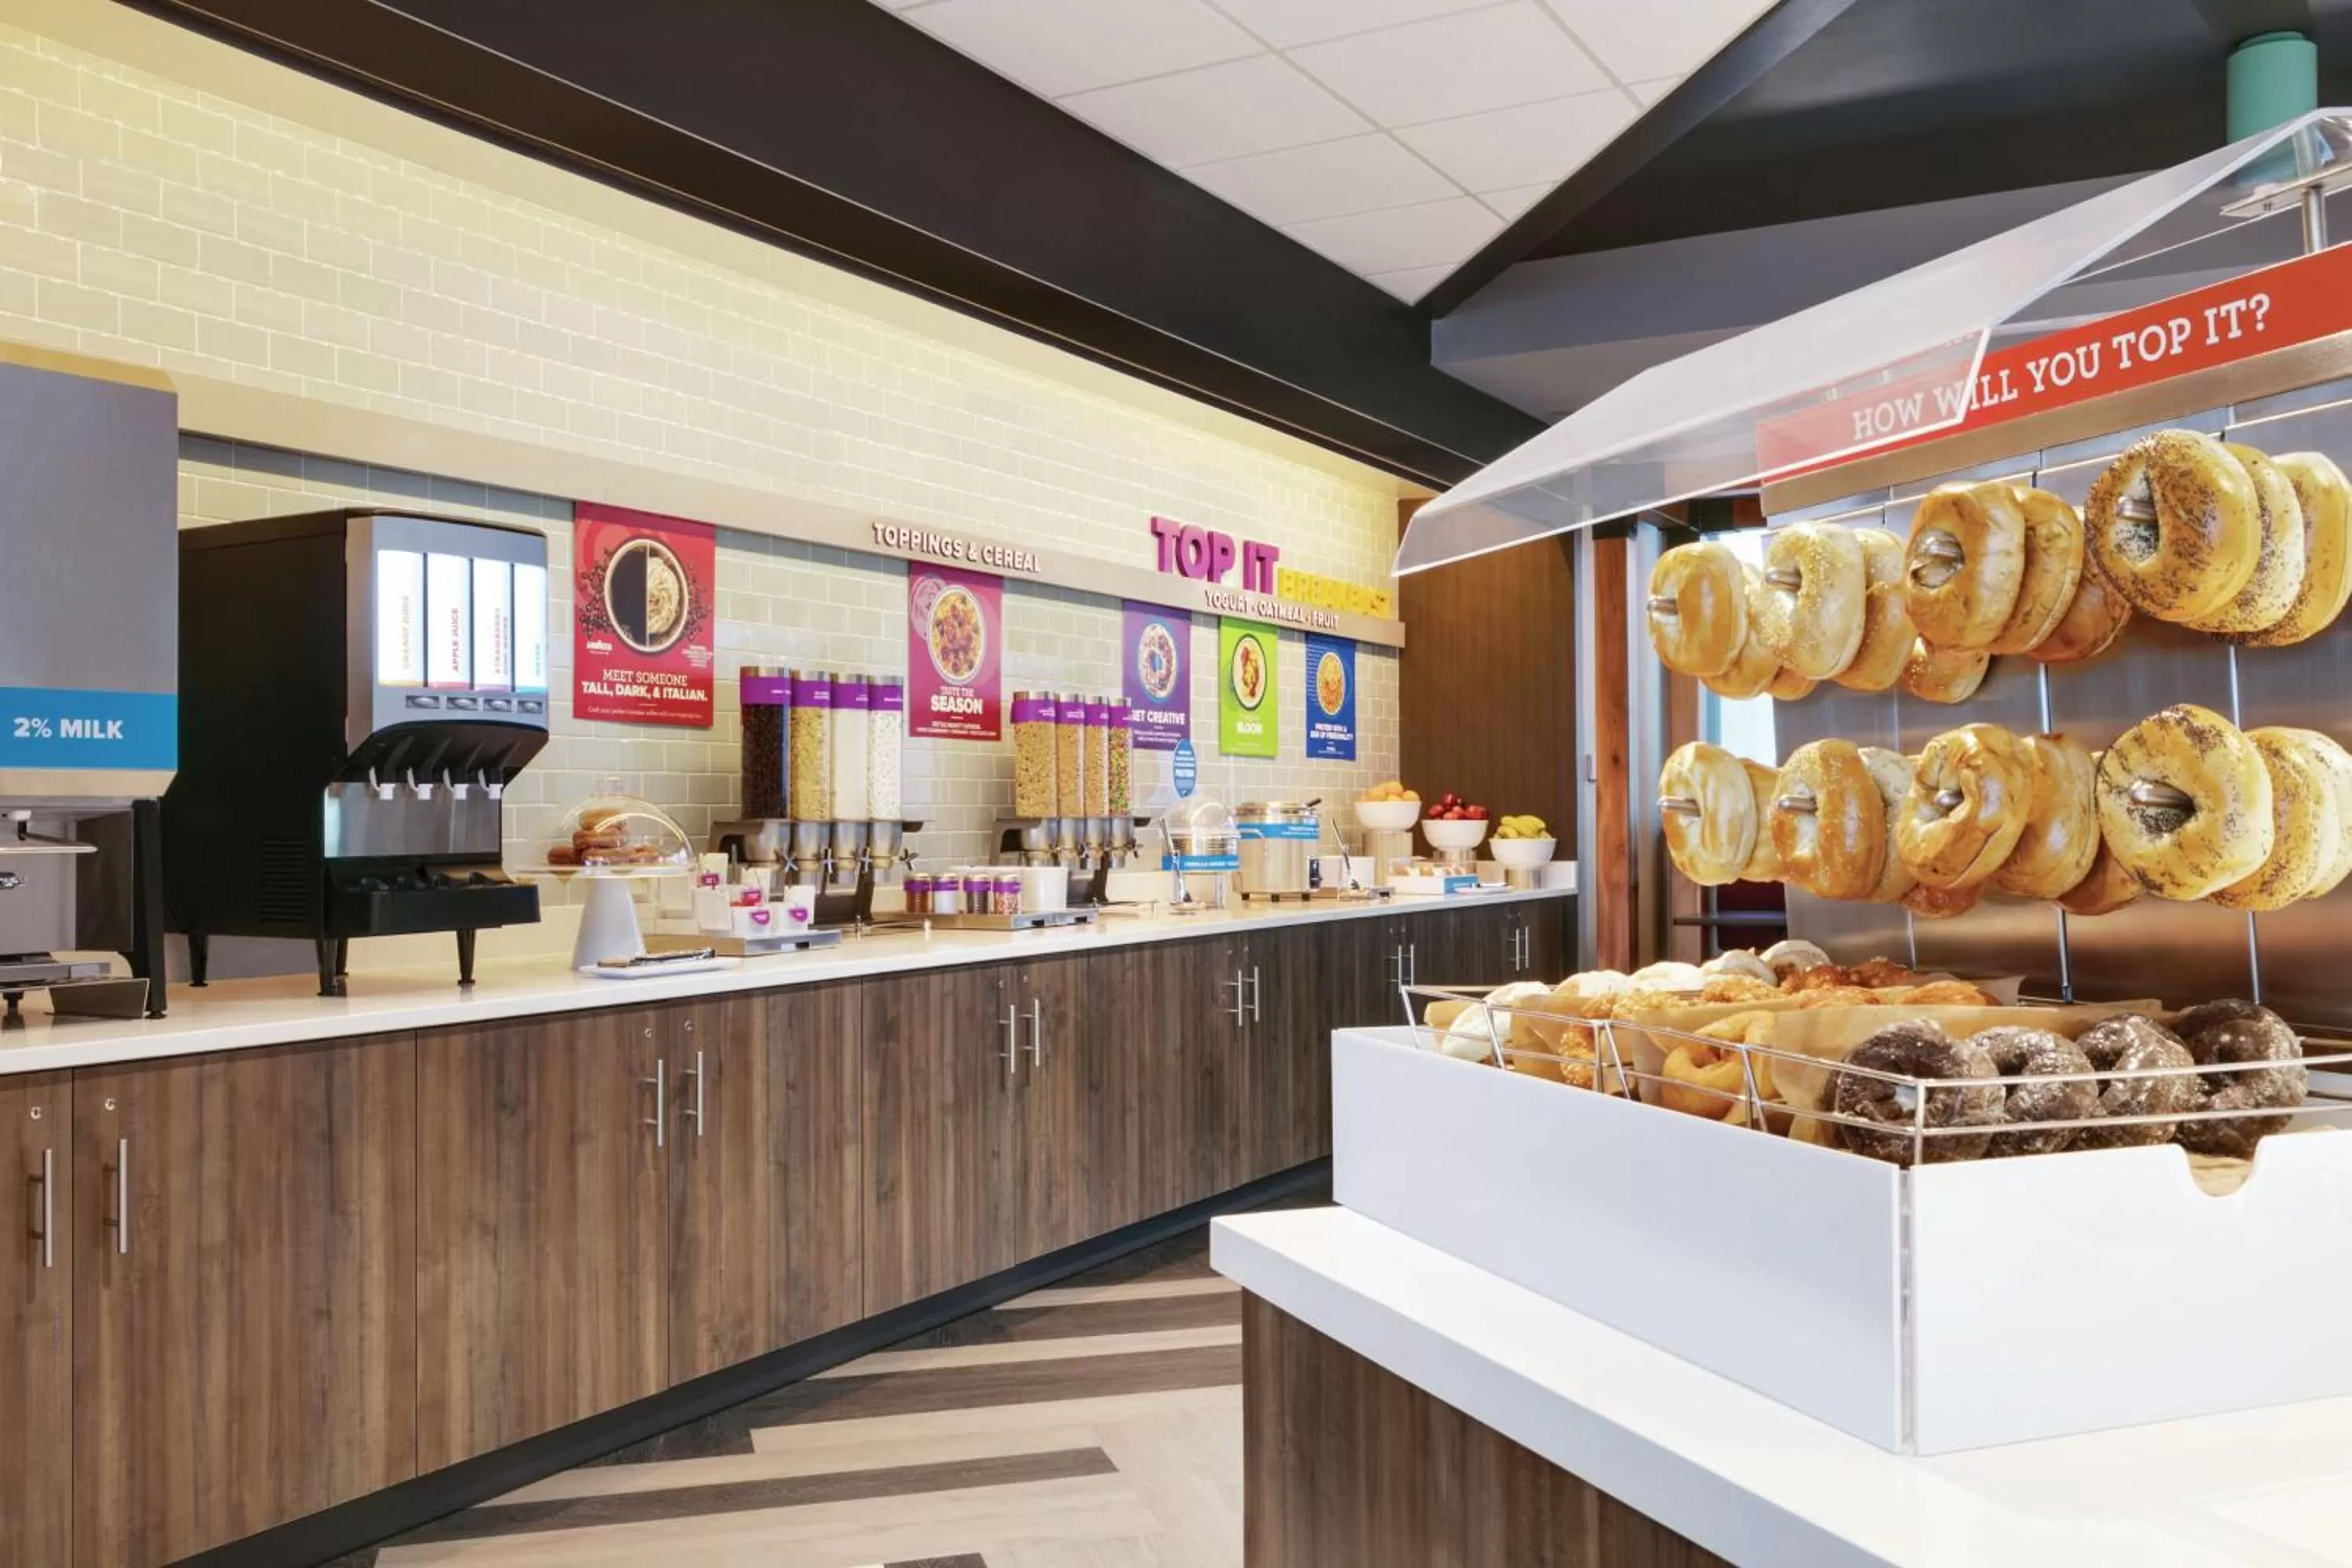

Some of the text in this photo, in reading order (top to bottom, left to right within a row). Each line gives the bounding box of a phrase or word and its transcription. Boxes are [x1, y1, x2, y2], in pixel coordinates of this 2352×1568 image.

[1852, 292, 2271, 441] HOW WILL YOU TOP IT?
[872, 521, 1041, 572] TOPPINGS & CEREAL
[1151, 516, 1280, 595] TOP IT
[1205, 590, 1340, 630] YOGURT OATMEAL FRUIT
[603, 669, 688, 686] MEET SOMEONE
[582, 681, 707, 702] TALL, DARK, & ITALIAN.
[931, 695, 983, 714] SEASON
[13, 717, 124, 739] 2% MILK
[1147, 710, 1186, 724] CREATIVE
